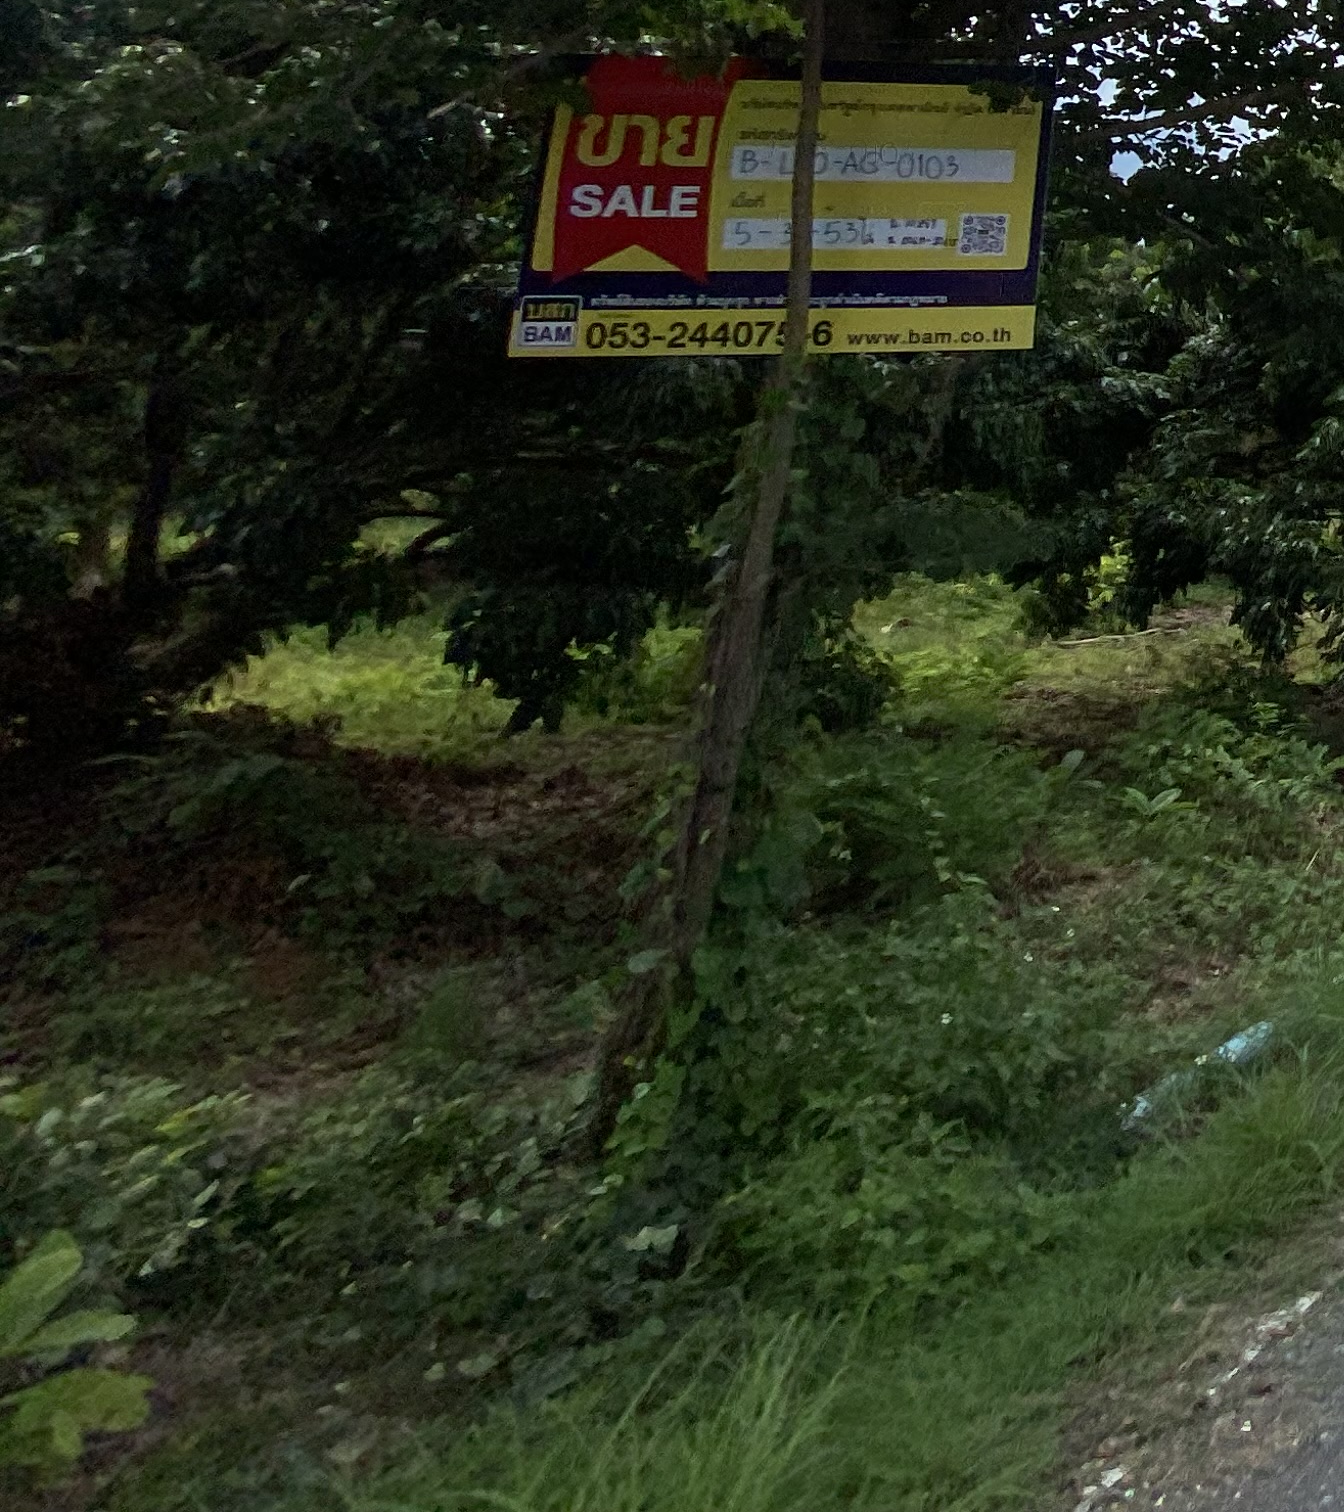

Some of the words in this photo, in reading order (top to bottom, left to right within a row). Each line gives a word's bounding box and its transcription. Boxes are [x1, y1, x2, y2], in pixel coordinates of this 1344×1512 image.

[577, 114, 715, 167] ขาย
[569, 184, 701, 218] SALE
[524, 325, 572, 343] BAM
[847, 327, 1011, 345] www.bam.co.th
